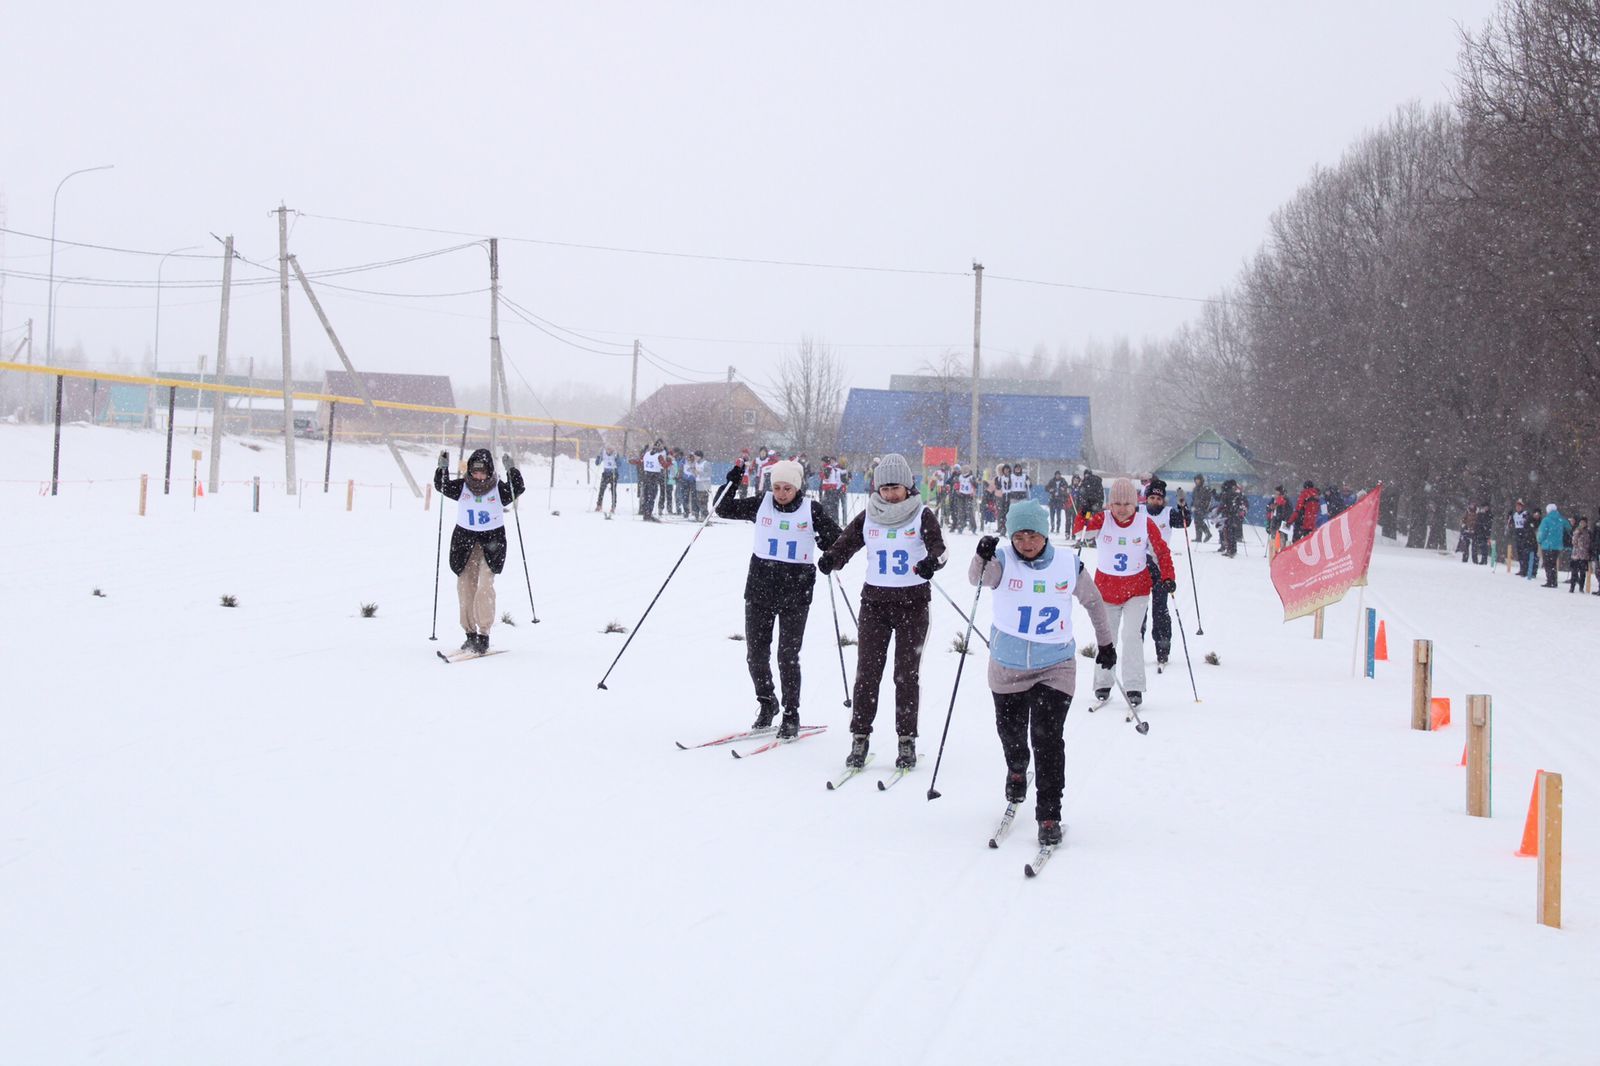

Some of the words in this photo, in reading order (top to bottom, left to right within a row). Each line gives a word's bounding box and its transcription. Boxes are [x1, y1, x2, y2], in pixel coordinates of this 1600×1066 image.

[467, 509, 490, 525] 18
[768, 539, 797, 559] 11
[876, 550, 908, 575] 13
[1113, 553, 1128, 571] 3
[1008, 579, 1023, 588] ГТО
[1018, 606, 1060, 634] 12
